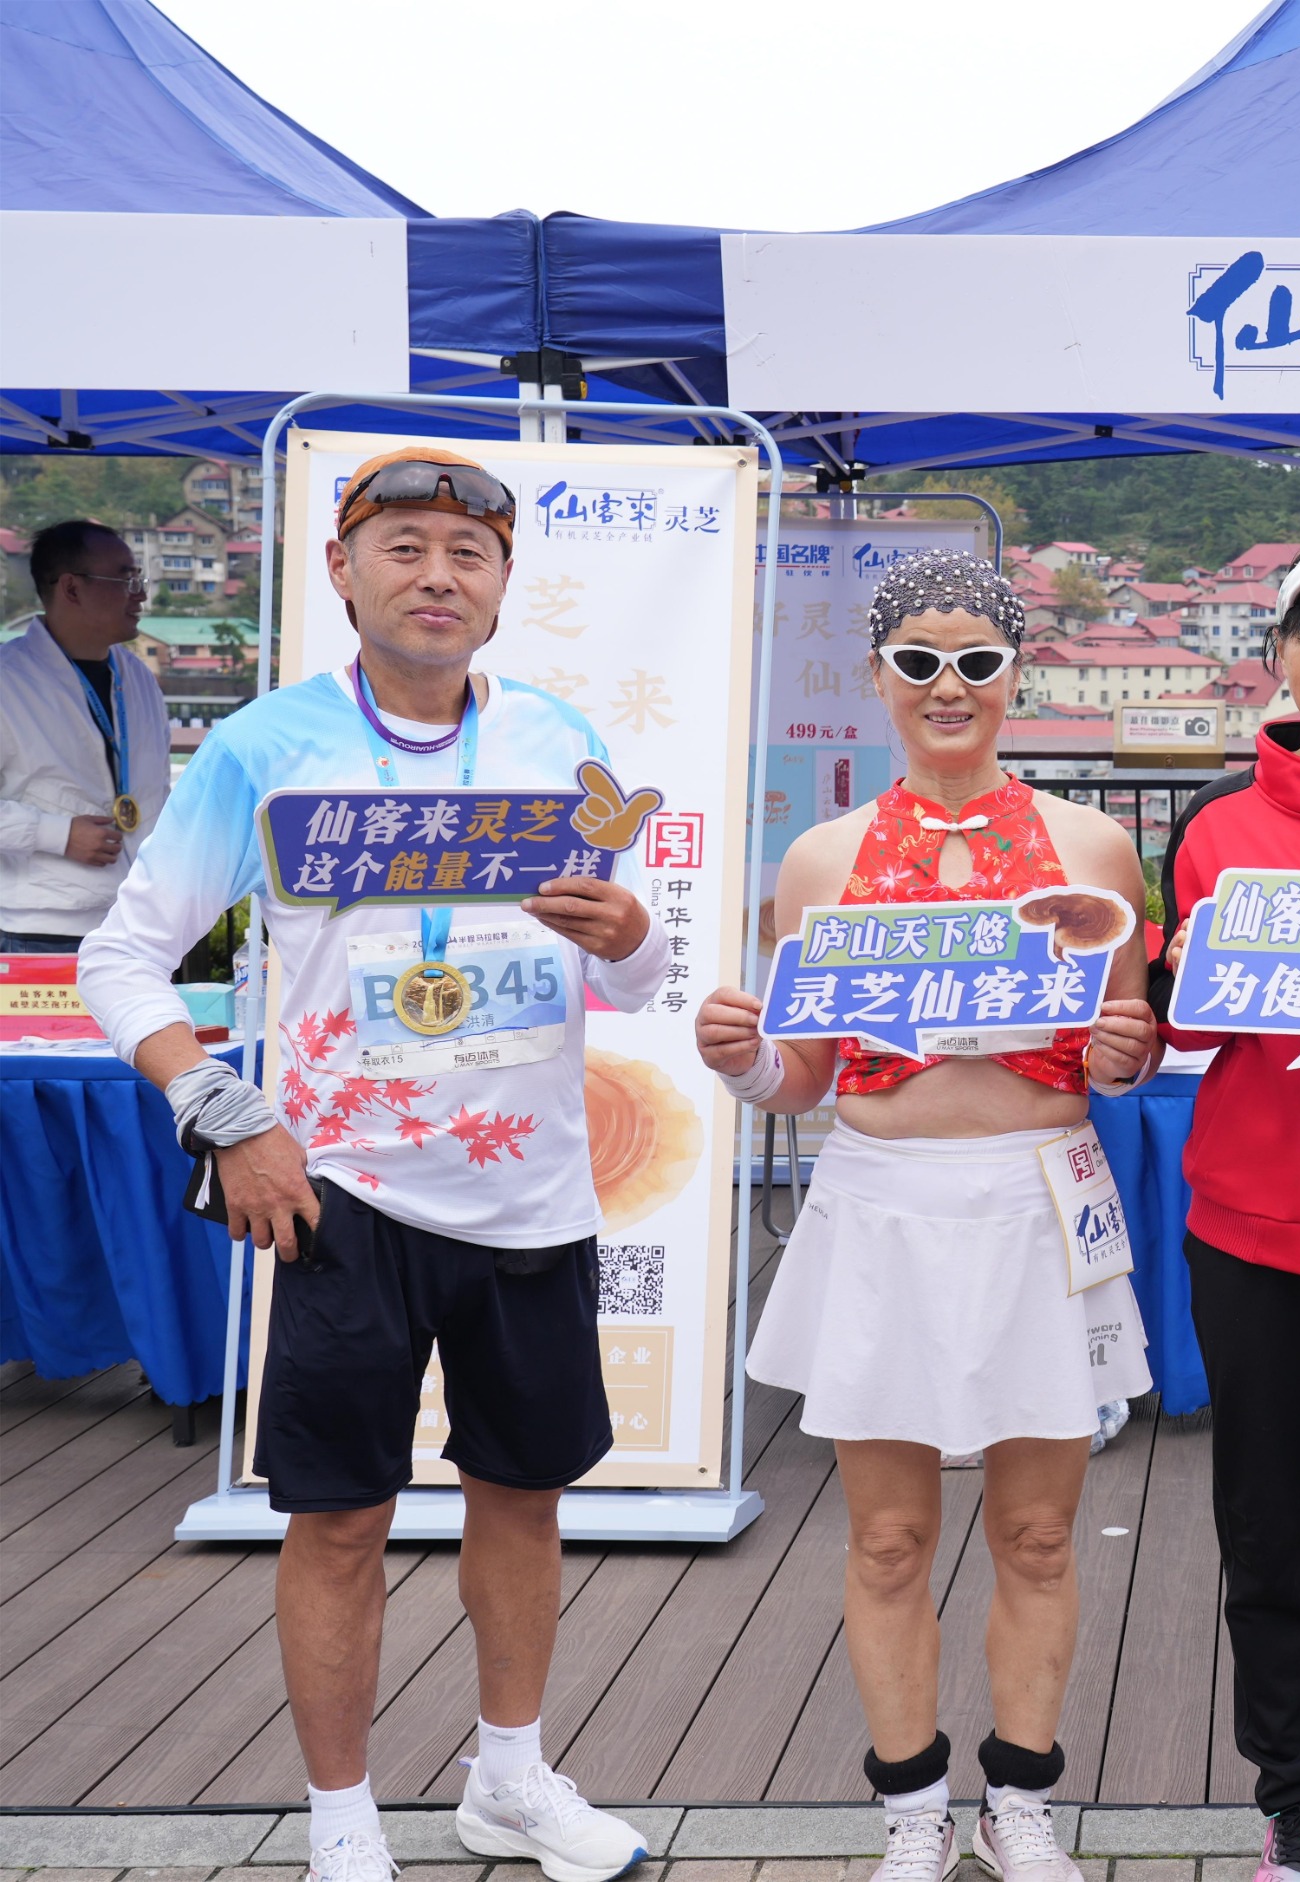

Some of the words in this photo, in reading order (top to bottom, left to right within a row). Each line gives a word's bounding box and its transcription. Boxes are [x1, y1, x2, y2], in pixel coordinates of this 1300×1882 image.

[555, 530, 653, 543] 有机灵芝全产业链
[305, 799, 565, 847] 仙客来灵芝
[292, 849, 603, 893] 这个能量不一样
[651, 878, 662, 907] China
[661, 879, 693, 1013] 中华老字号
[805, 912, 1011, 963] 庐山天下悠
[778, 965, 1086, 1028] 灵芝仙客来
[607, 1346, 651, 1365] 企业
